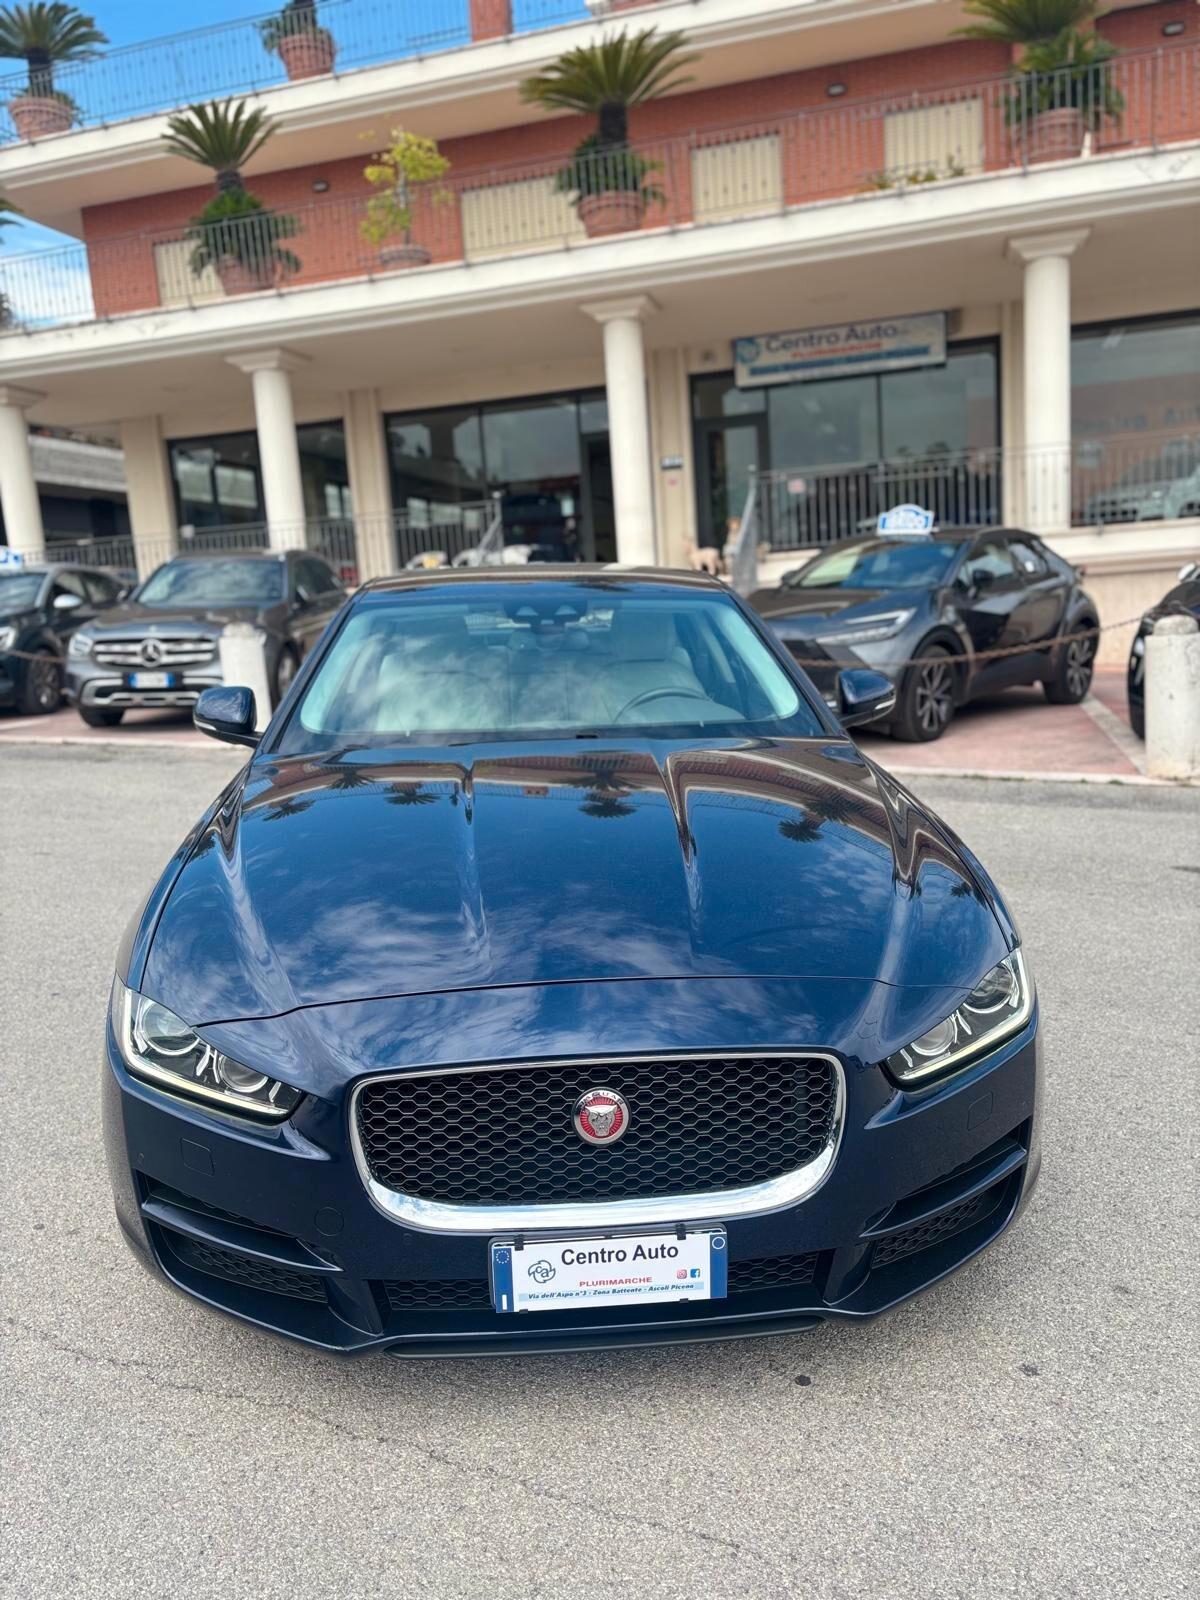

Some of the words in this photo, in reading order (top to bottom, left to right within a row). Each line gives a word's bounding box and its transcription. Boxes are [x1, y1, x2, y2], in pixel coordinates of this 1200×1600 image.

[765, 331, 840, 351] Centro
[846, 323, 898, 341] Auto
[561, 1248, 627, 1266] Centro
[632, 1243, 679, 1260] Auto
[579, 1277, 653, 1287] PLURIMARCHE
